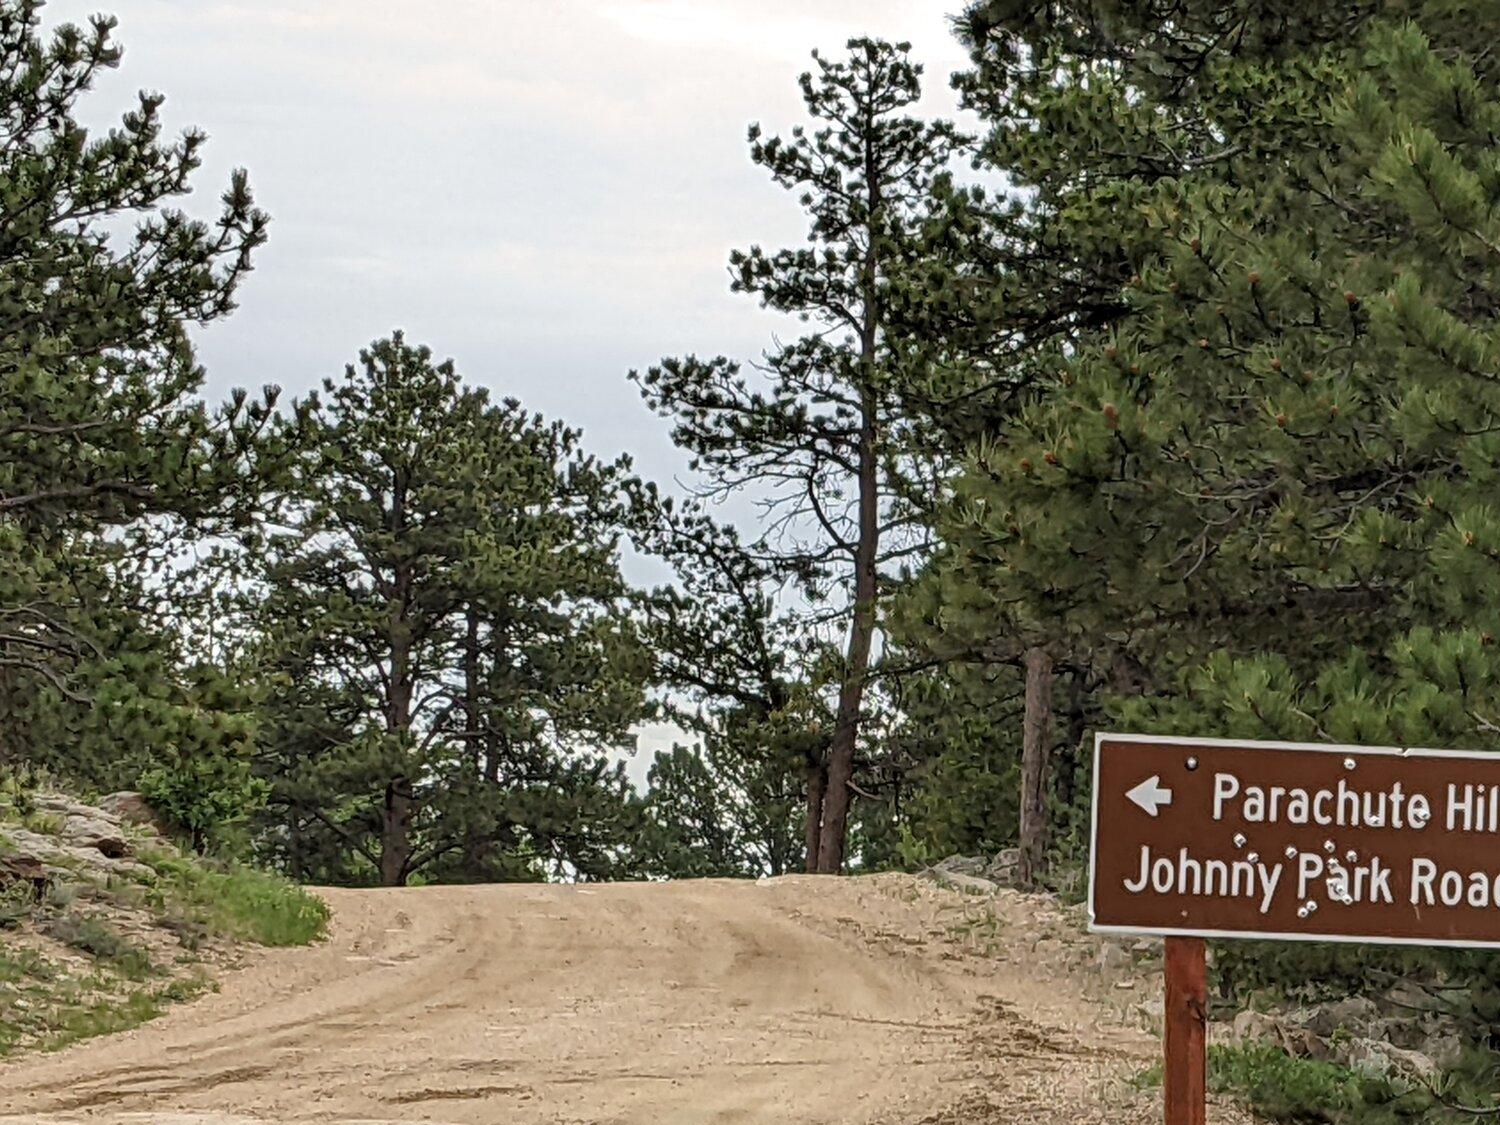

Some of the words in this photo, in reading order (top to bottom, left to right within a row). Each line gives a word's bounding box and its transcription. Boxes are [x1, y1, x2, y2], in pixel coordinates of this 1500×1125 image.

[1213, 772, 1431, 831] Parachute
[1123, 845, 1283, 914] Johnny
[1297, 853, 1394, 903] Park
